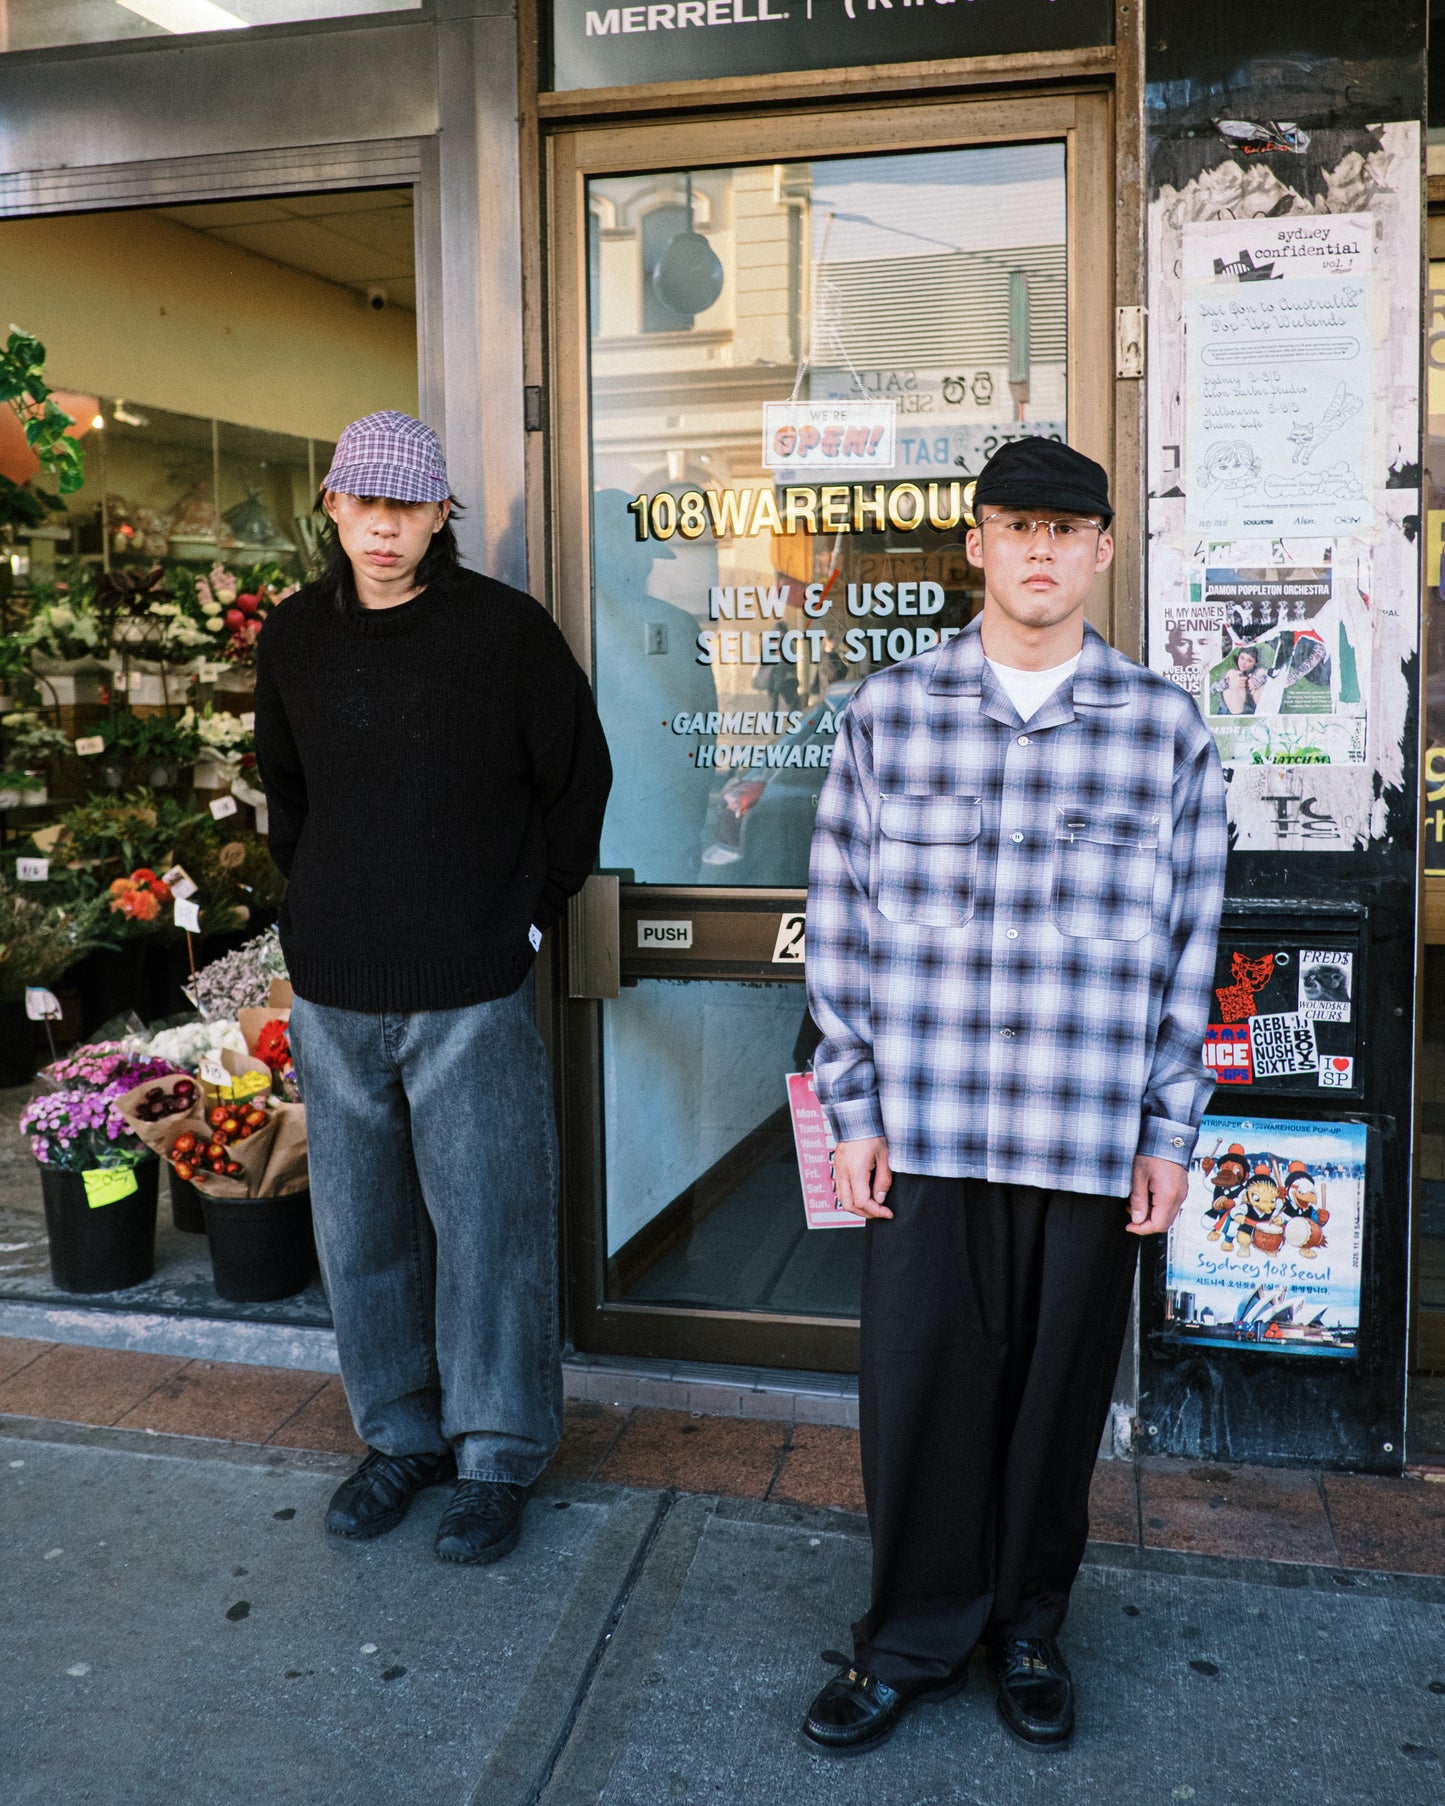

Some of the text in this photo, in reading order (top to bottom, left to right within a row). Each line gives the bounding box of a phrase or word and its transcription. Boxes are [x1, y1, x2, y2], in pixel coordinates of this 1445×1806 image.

[1254, 241, 1360, 259] confidential
[810, 410, 847, 421] WE'RE
[772, 425, 885, 459] OPEN!
[1208, 584, 1330, 596] DAMON POPPLETON ORCHESTRA
[709, 581, 945, 620] NEW & USED
[1176, 607, 1190, 618] MY
[1191, 606, 1215, 617] NAME
[1217, 606, 1224, 616] IS
[1165, 619, 1222, 632] DENNIS
[696, 629, 826, 666] SELECT
[672, 710, 803, 736] GARMENTS
[643, 927, 688, 941] PUSH
[1302, 951, 1350, 965] FRED$
[1305, 1010, 1342, 1021] CHUR$
[1252, 1016, 1290, 1033] AEBL
[1253, 1030, 1293, 1047] CURE
[1255, 1044, 1294, 1060] NUSH
[1293, 1029, 1317, 1070] BOYS
[1257, 1058, 1296, 1074] SIXTE
[1325, 1058, 1330, 1070] I
[1323, 1072, 1348, 1086] SP
[796, 1109, 820, 1119] Mon.
[798, 1124, 822, 1133] Tues.
[1313, 1126, 1342, 1135] POP-UP
[800, 1139, 824, 1149] Wed.
[802, 1154, 826, 1164] Thur.
[804, 1169, 821, 1179] Fri.
[807, 1184, 826, 1194] Sat.
[809, 1199, 831, 1209] Sun.
